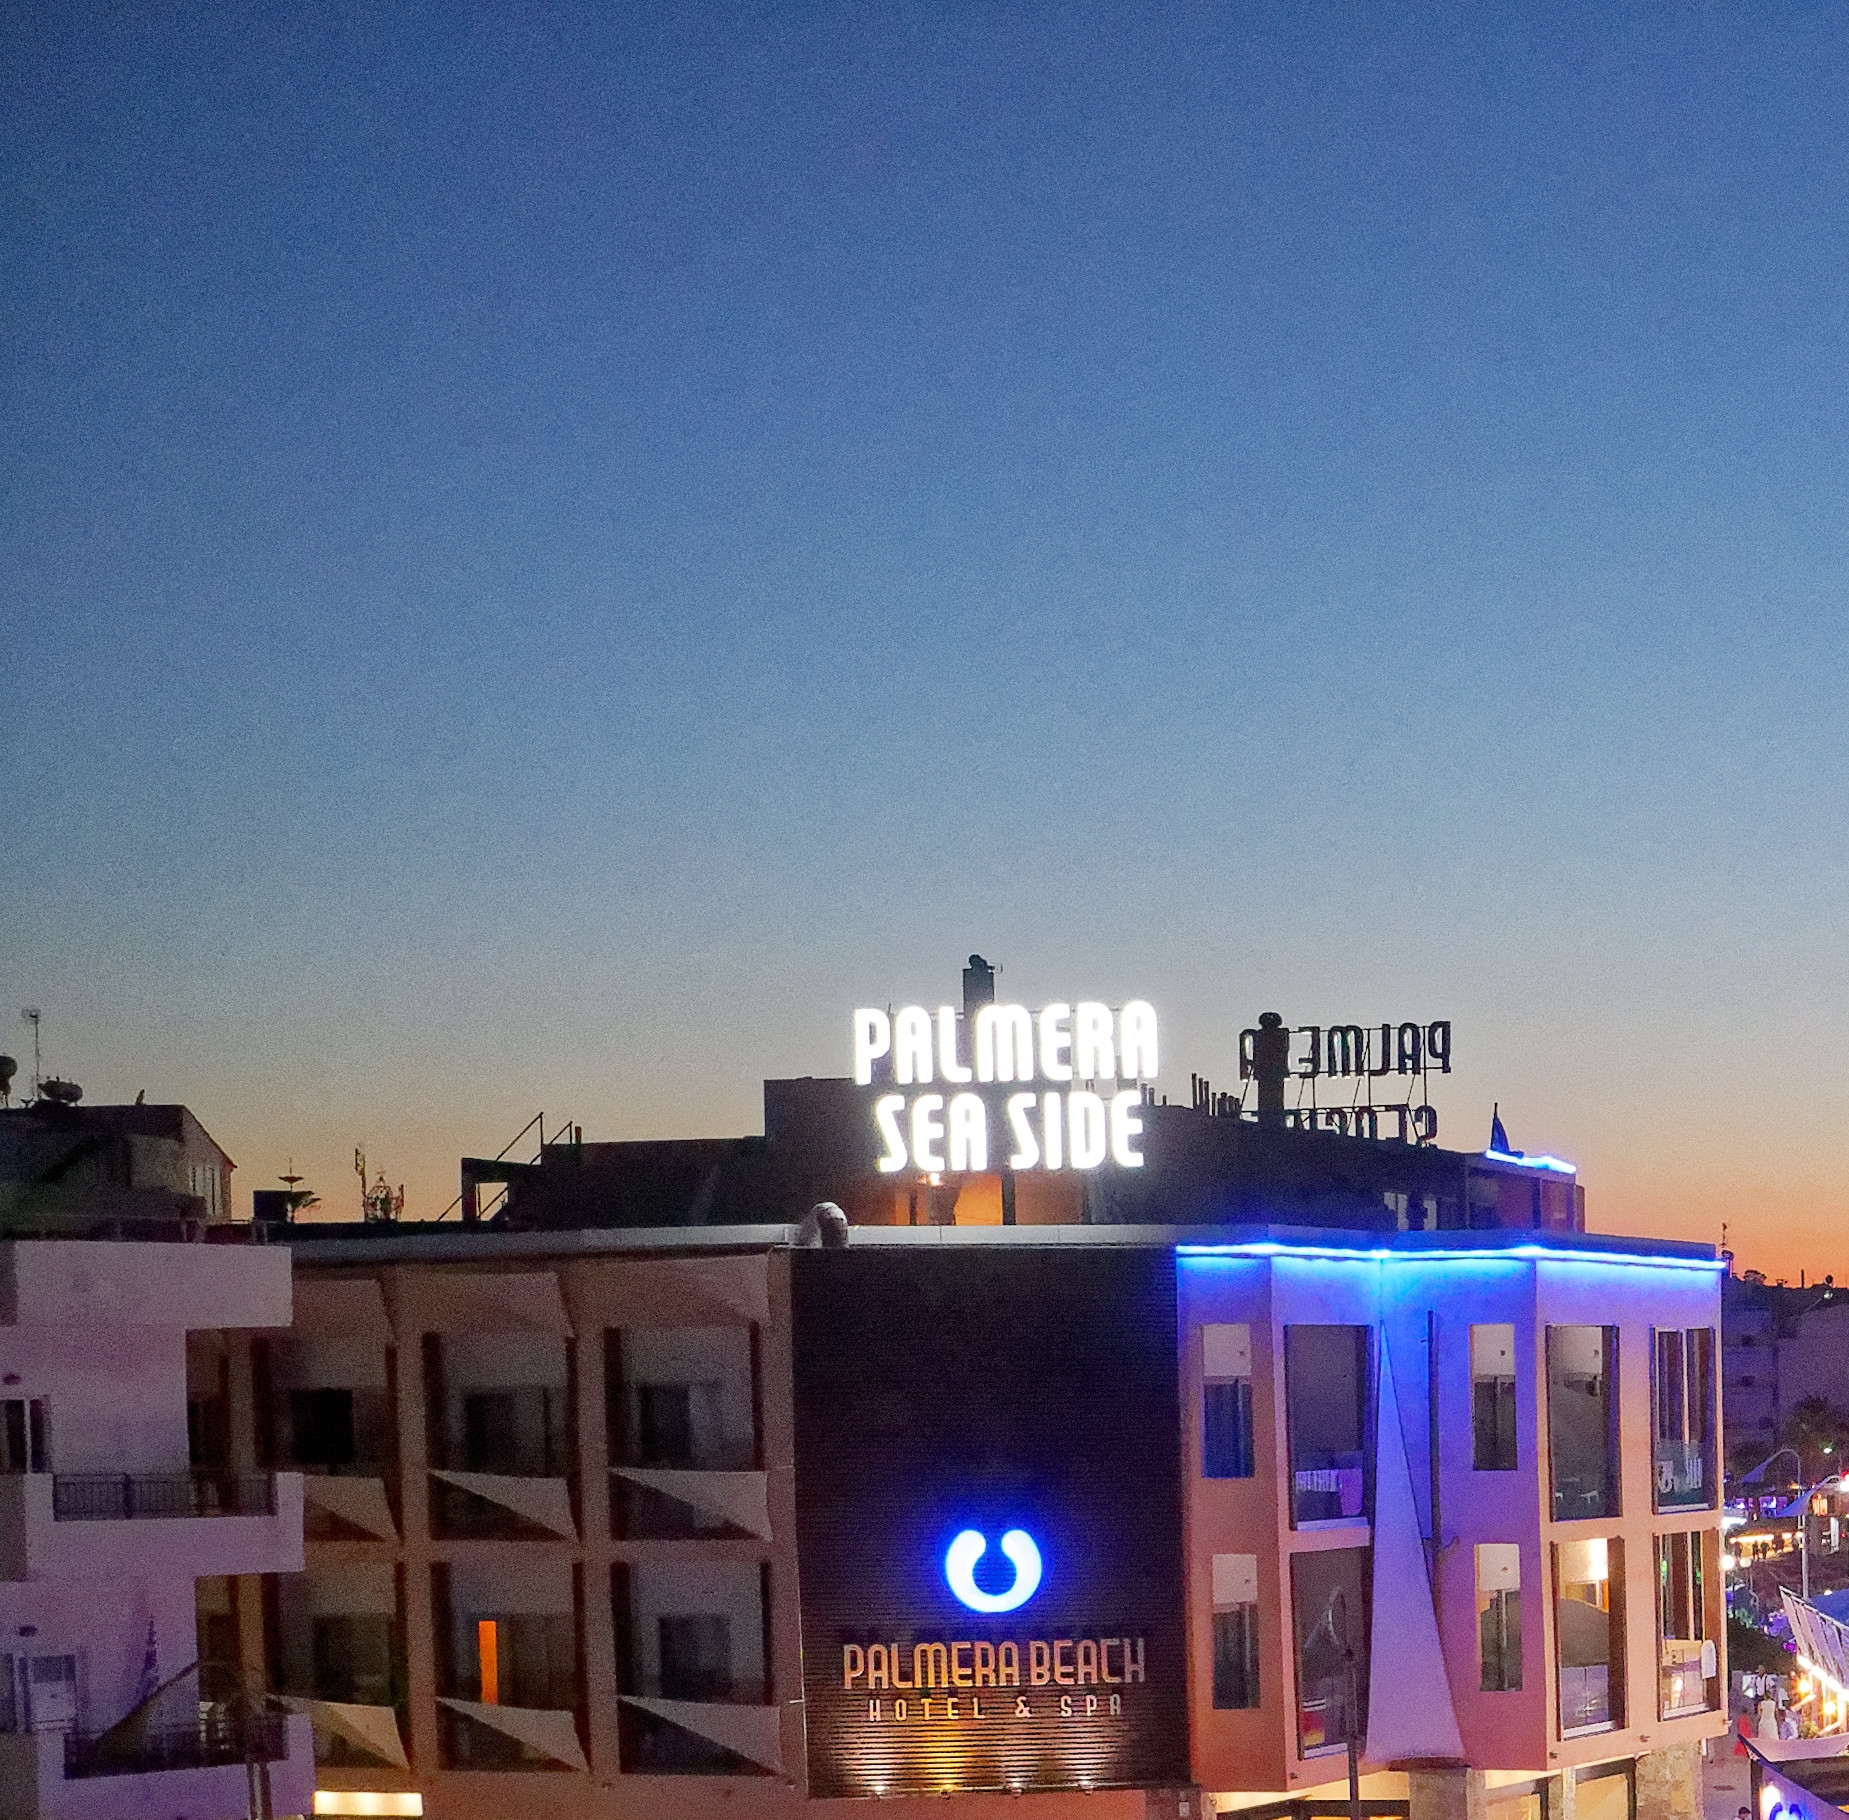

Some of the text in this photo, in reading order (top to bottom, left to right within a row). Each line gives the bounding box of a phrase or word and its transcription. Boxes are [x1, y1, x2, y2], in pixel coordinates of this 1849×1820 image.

[853, 1000, 1159, 1085] PALMERA
[876, 1093, 988, 1172] SEA
[1007, 1089, 1145, 1171] SIDE
[843, 1637, 1145, 1690] PALMERA BEACH
[869, 1693, 1122, 1721] HOTEL & SPA
